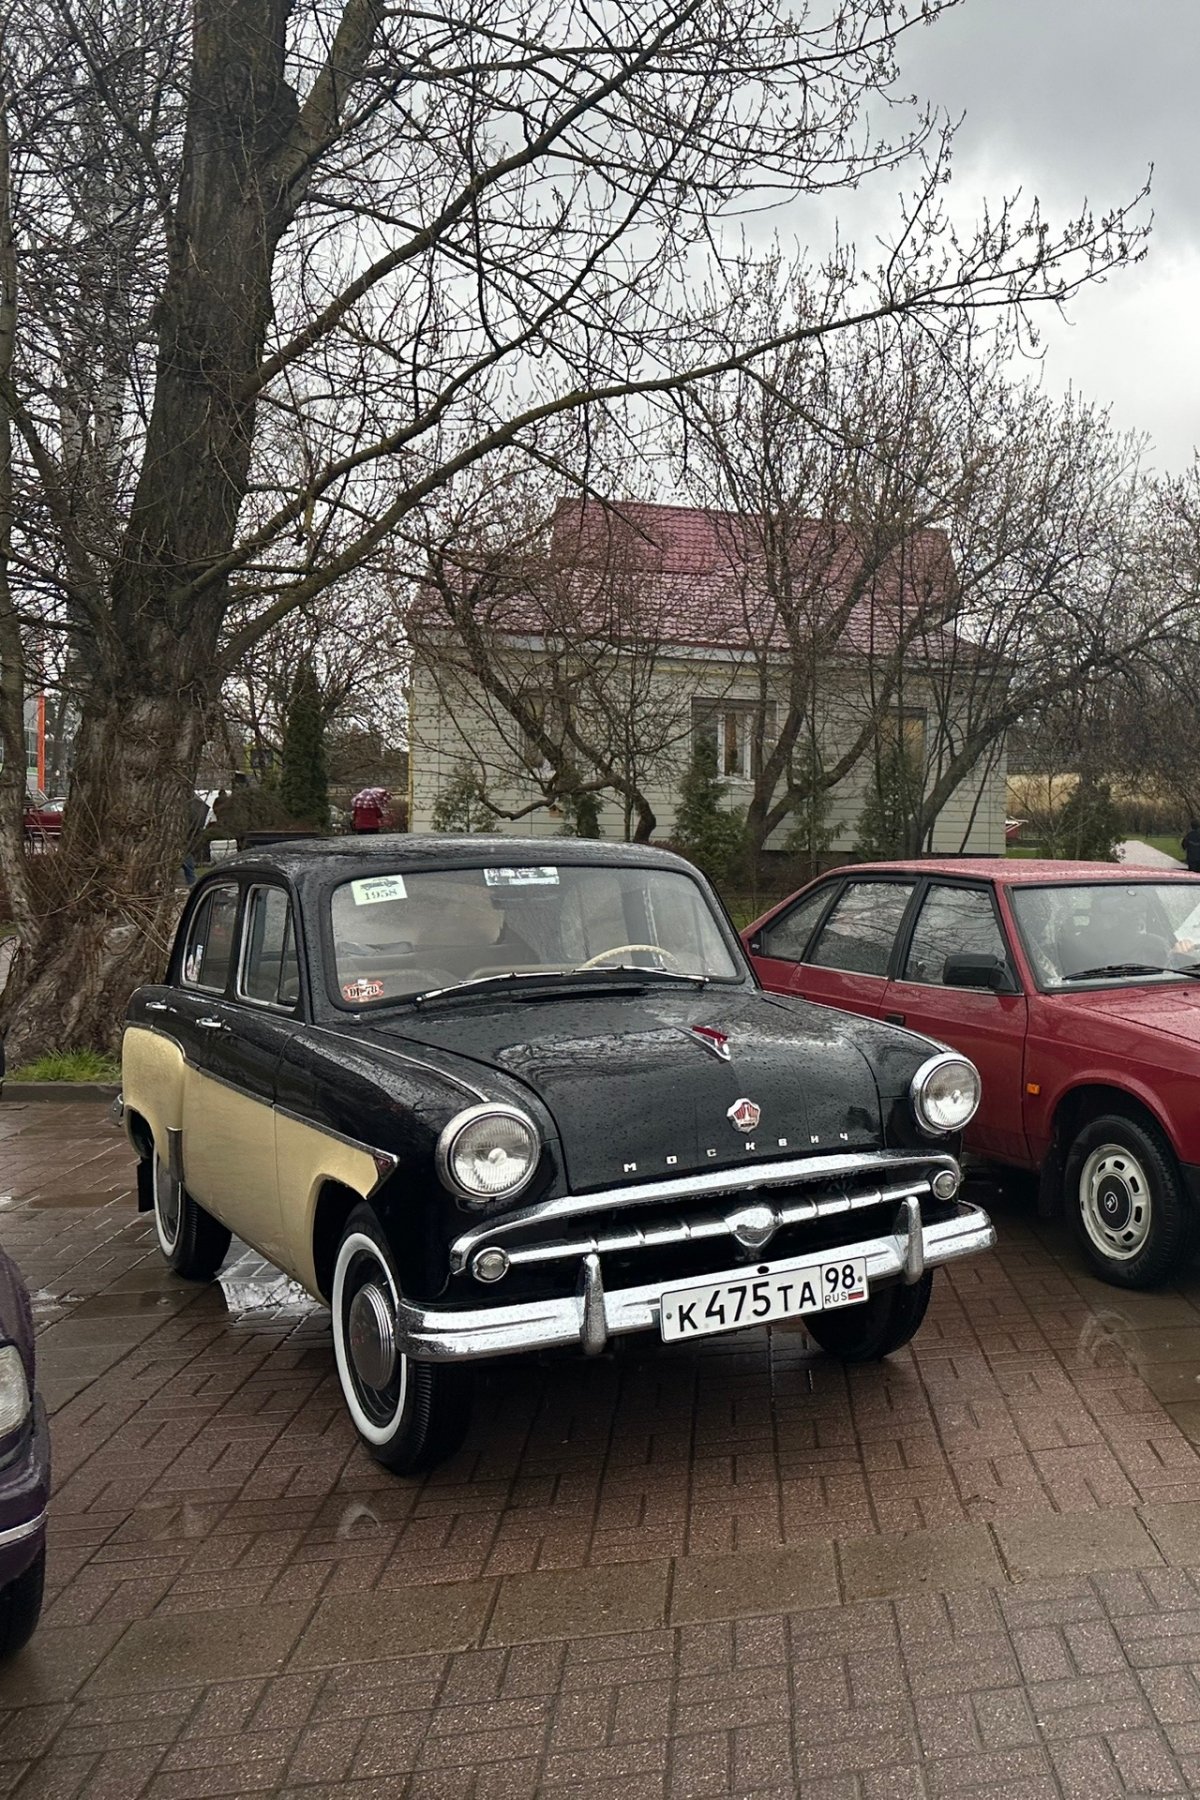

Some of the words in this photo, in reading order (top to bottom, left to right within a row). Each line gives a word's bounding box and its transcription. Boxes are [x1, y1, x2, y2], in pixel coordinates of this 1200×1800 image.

[365, 889, 398, 900] 1958
[623, 1132, 849, 1173] МОСКВИЧ
[678, 1281, 817, 1333] К475ТА
[825, 1264, 856, 1294] 98
[825, 1291, 848, 1305] RUS
